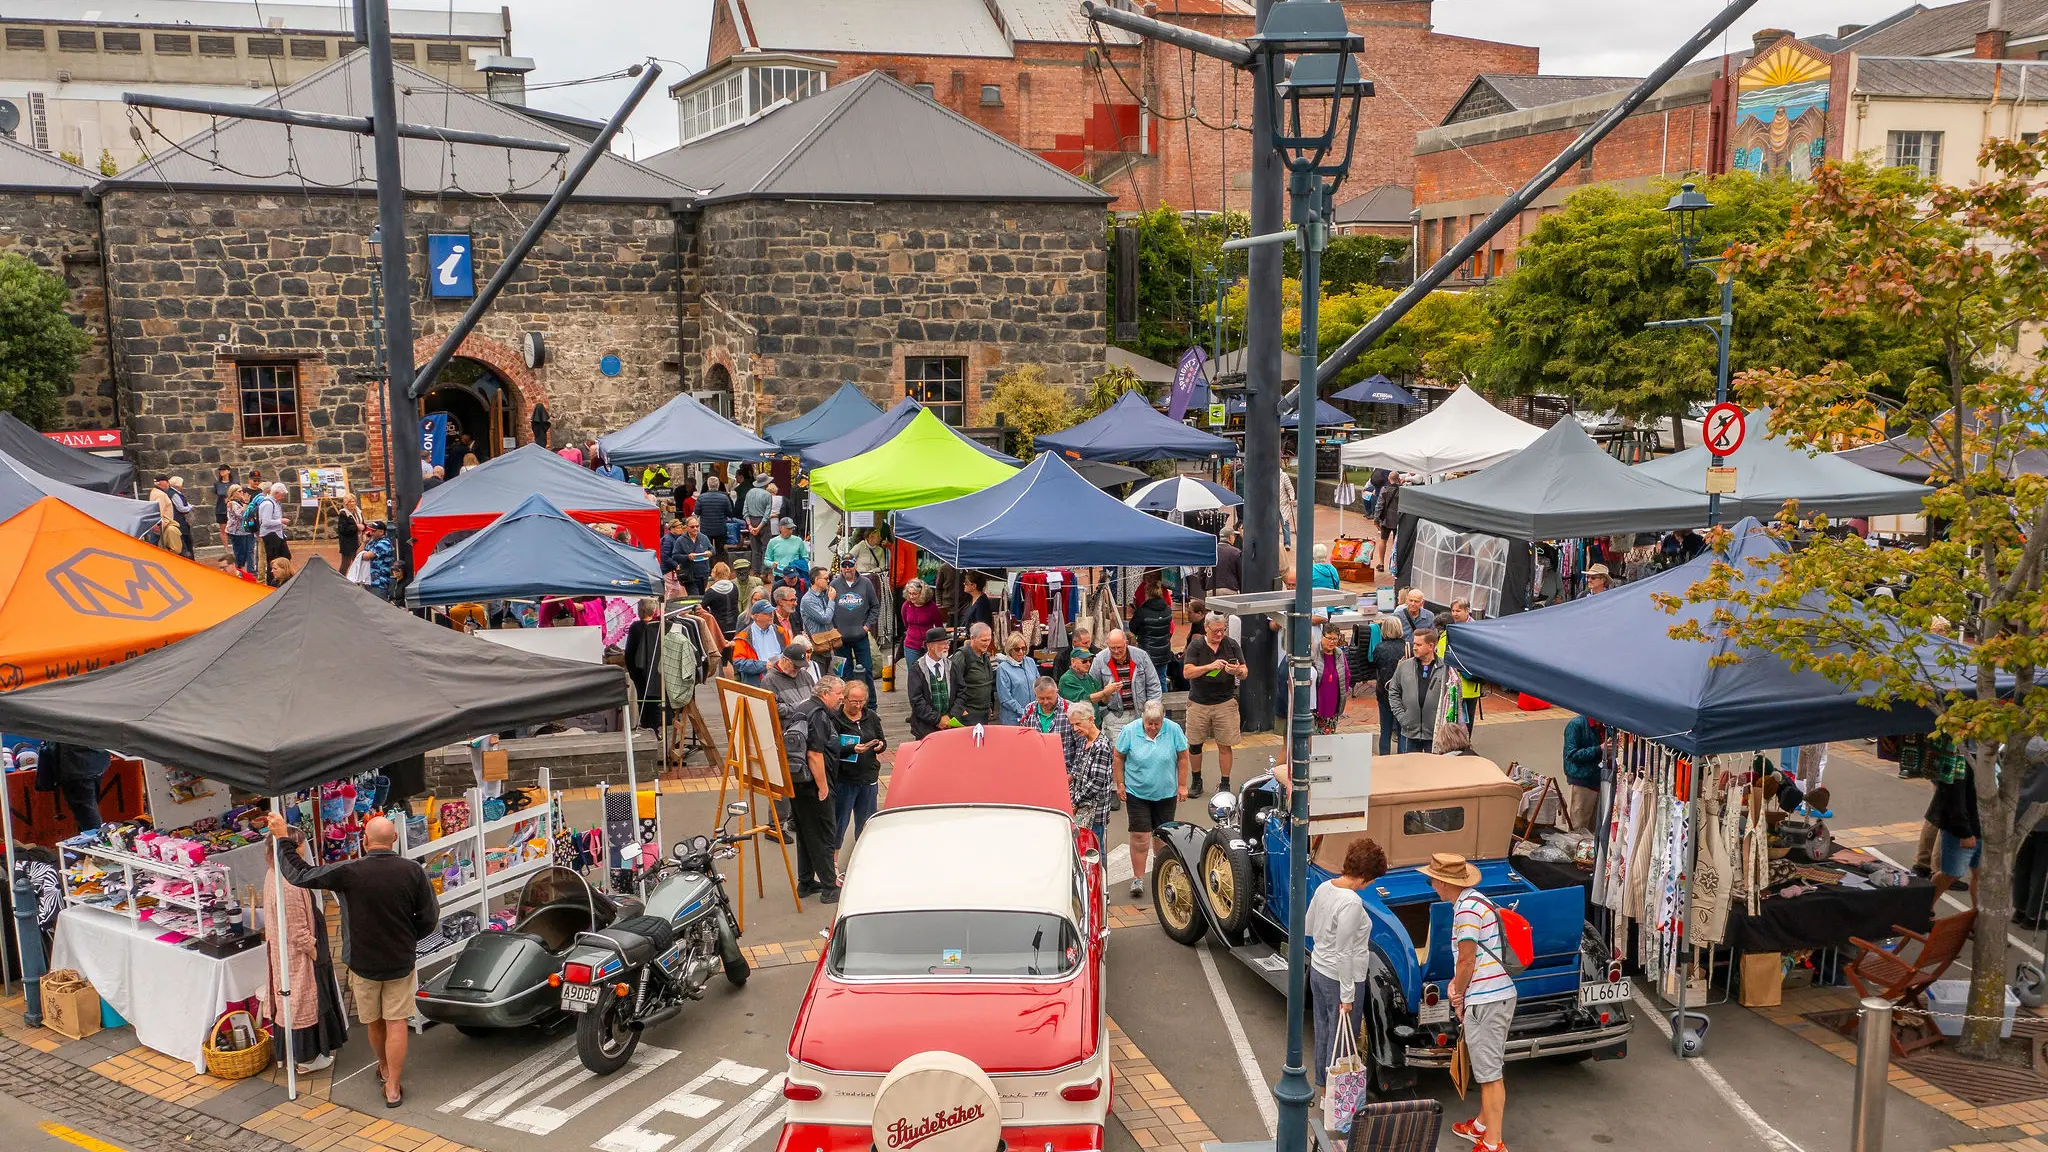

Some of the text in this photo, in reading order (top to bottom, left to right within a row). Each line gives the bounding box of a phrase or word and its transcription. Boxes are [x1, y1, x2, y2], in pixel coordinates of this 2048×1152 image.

[423, 433, 434, 453] NO
[563, 984, 598, 1002] A9DBC
[1582, 981, 1630, 1002] YL6673
[834, 1088, 877, 1098] Studebak
[886, 1104, 985, 1149] Studebaker
